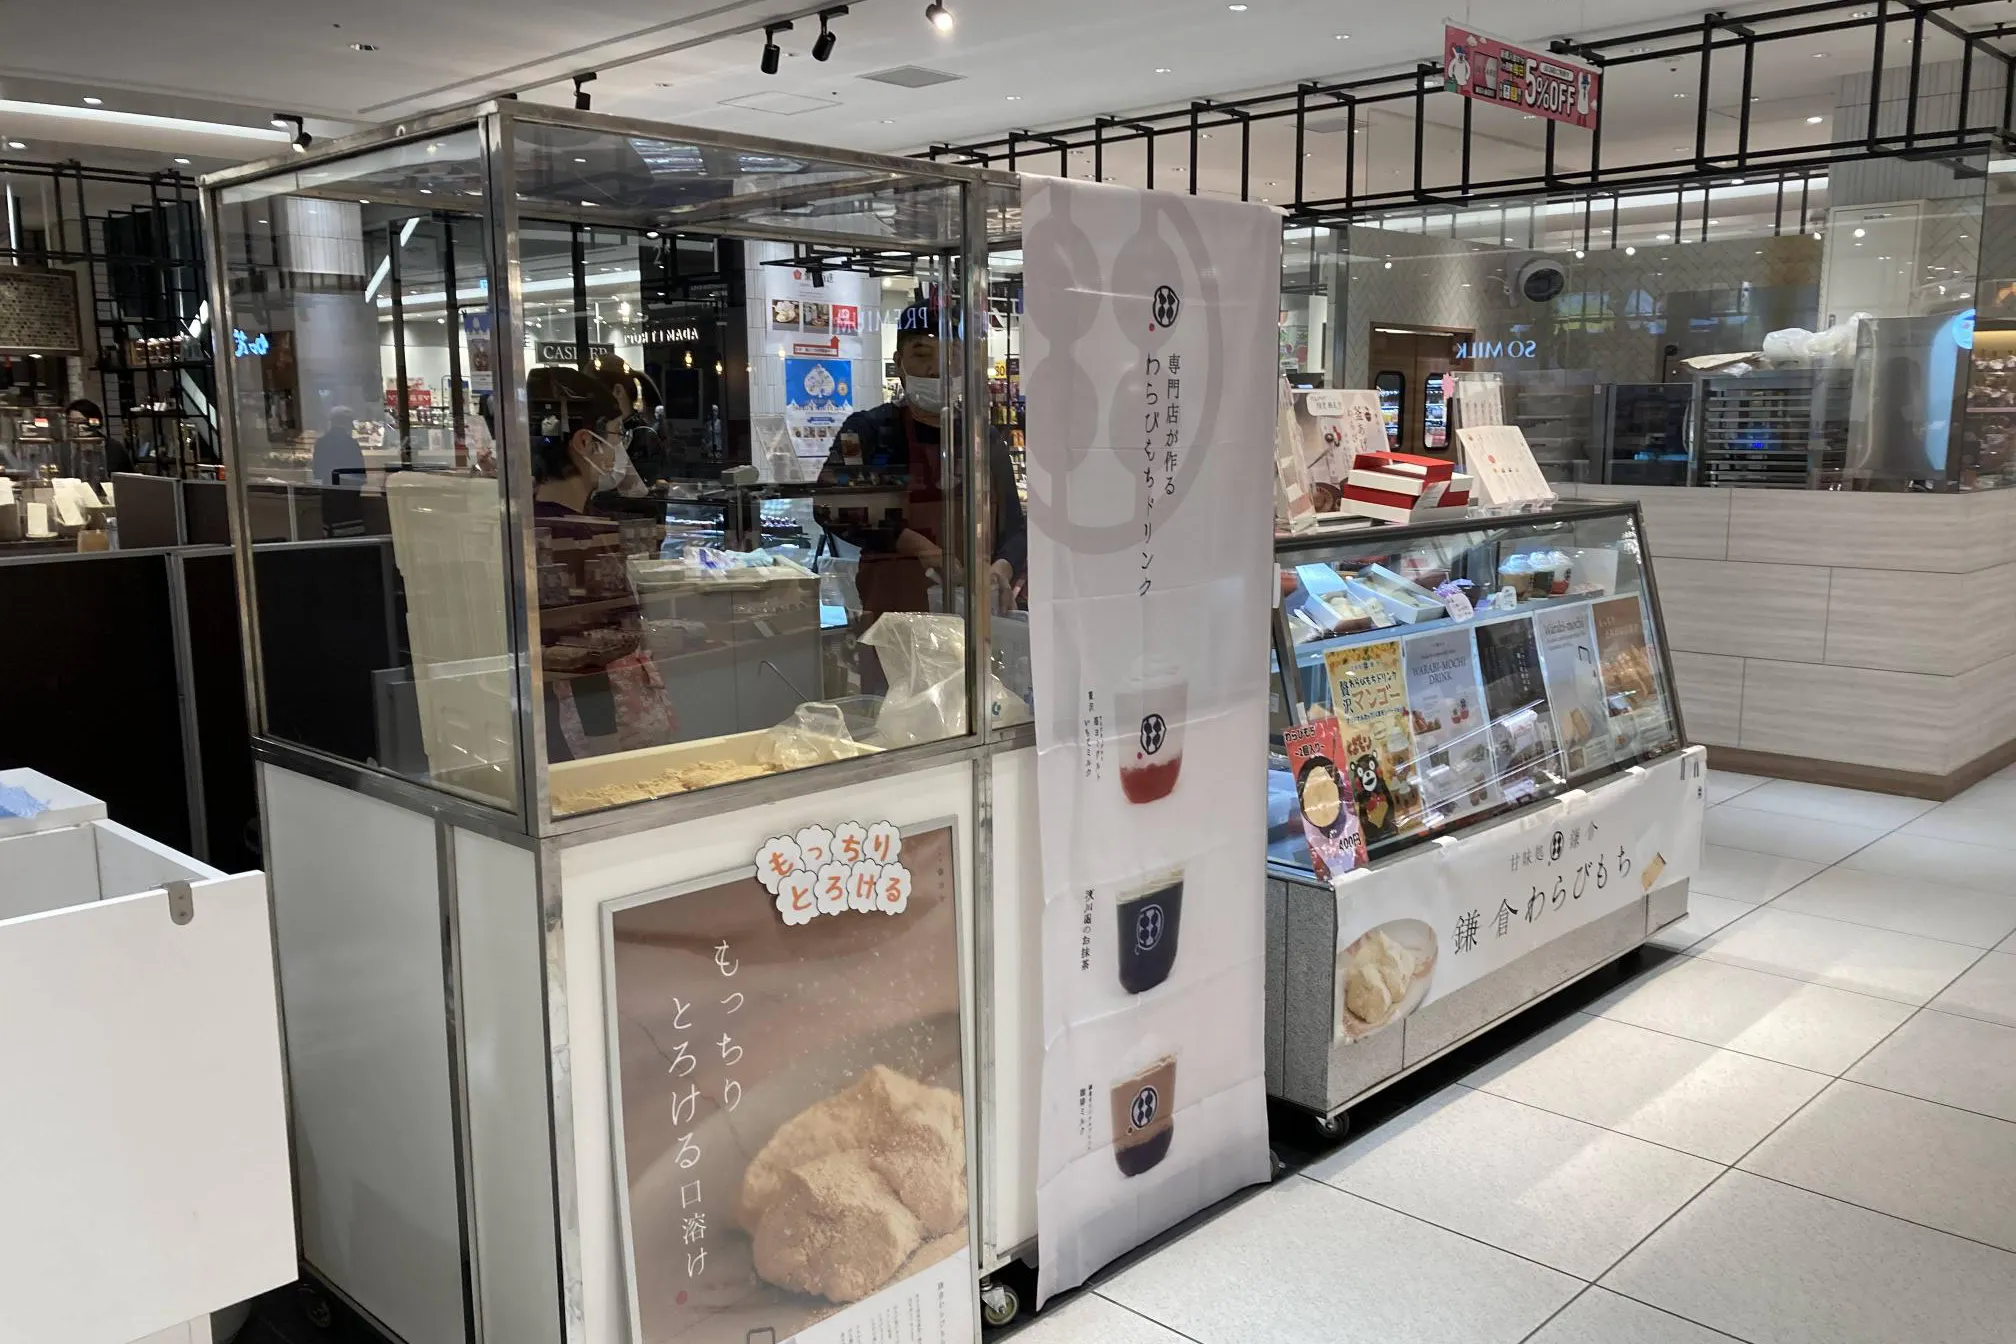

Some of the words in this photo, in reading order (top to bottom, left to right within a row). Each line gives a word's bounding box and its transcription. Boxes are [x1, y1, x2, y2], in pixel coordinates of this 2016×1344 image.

[1525, 58, 1576, 116] 5%OFF
[1163, 353, 1181, 496] 専門店が作る
[1138, 353, 1160, 597] わらびもちドリンク
[1412, 656, 1467, 677] WARABI-MOCHI
[1429, 671, 1453, 685] DRINK
[1352, 684, 1401, 711] マンゴー
[1285, 726, 1316, 742] わらびもち
[768, 834, 891, 876] もっちり
[1338, 832, 1362, 851] 400円
[791, 872, 901, 911] とろける
[1451, 845, 1631, 955] 鎌倉わらびもち
[713, 939, 744, 1113] もっちり
[668, 997, 708, 1279] とろける口溶け
